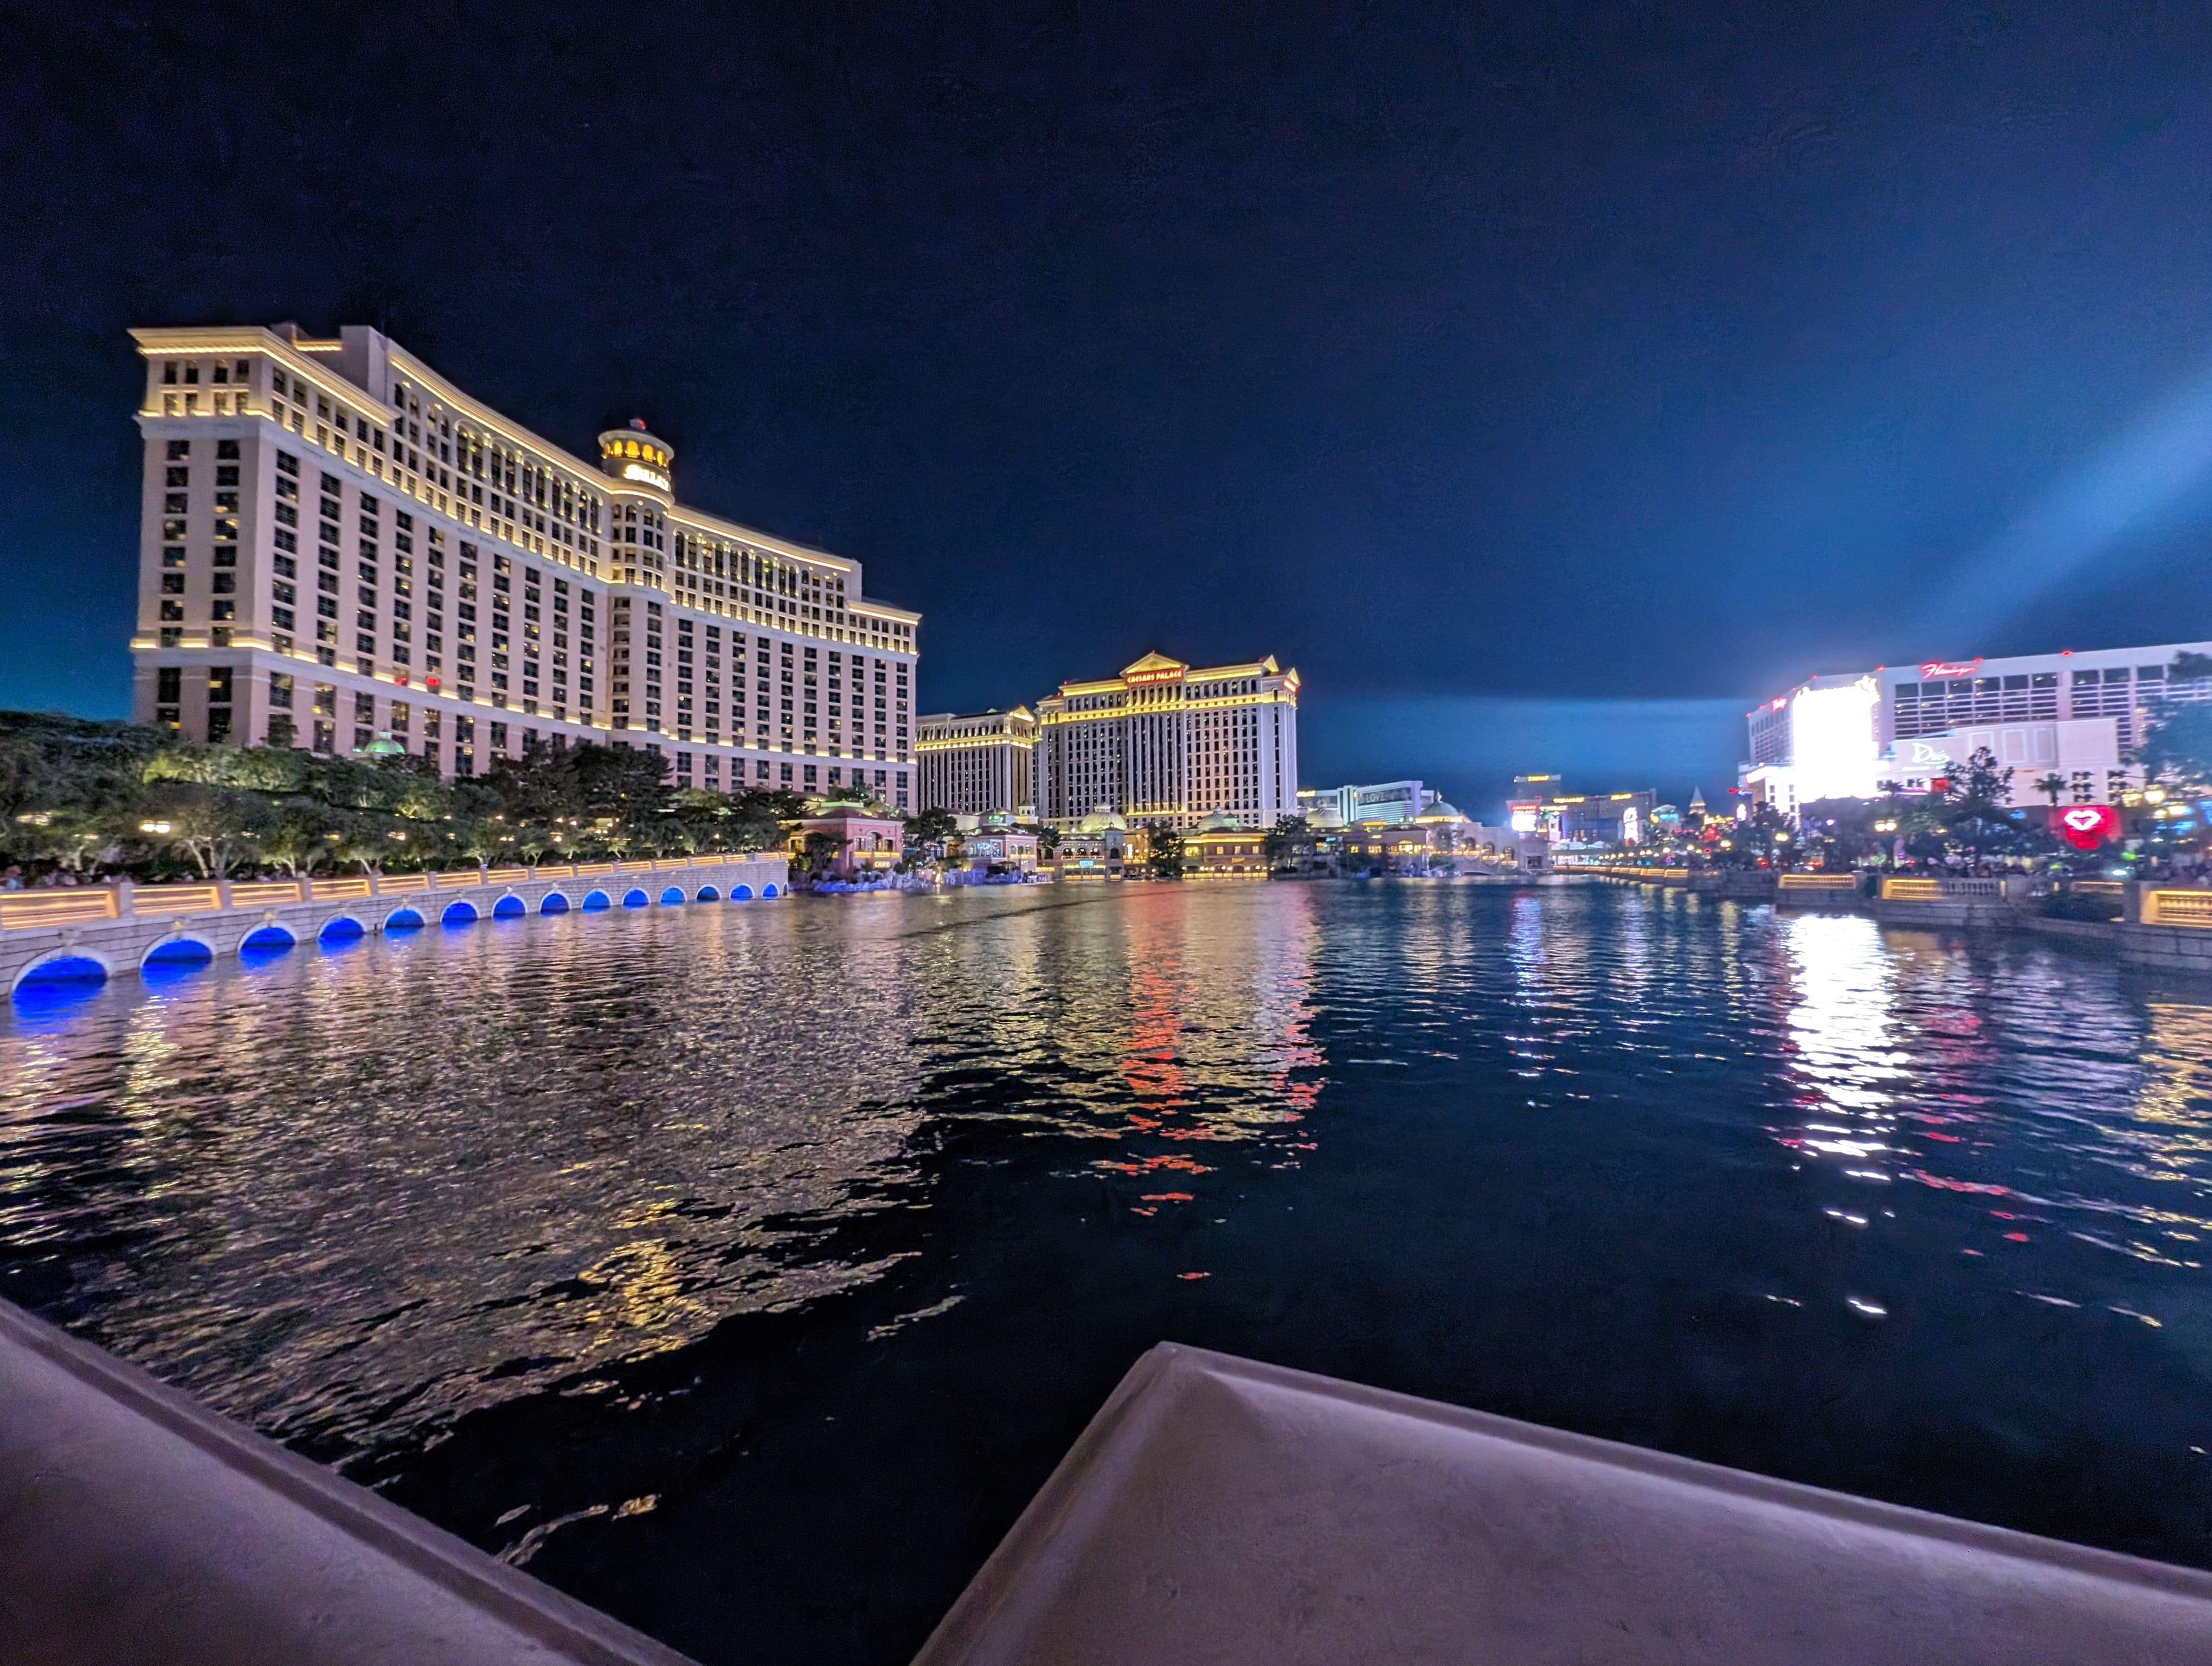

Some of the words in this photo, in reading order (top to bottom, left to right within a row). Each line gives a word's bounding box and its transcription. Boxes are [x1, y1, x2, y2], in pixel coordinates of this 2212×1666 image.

[1127, 674, 1155, 683] CAESARS
[1156, 670, 1182, 680] PALACE
[1366, 791, 1385, 803] LOVE
